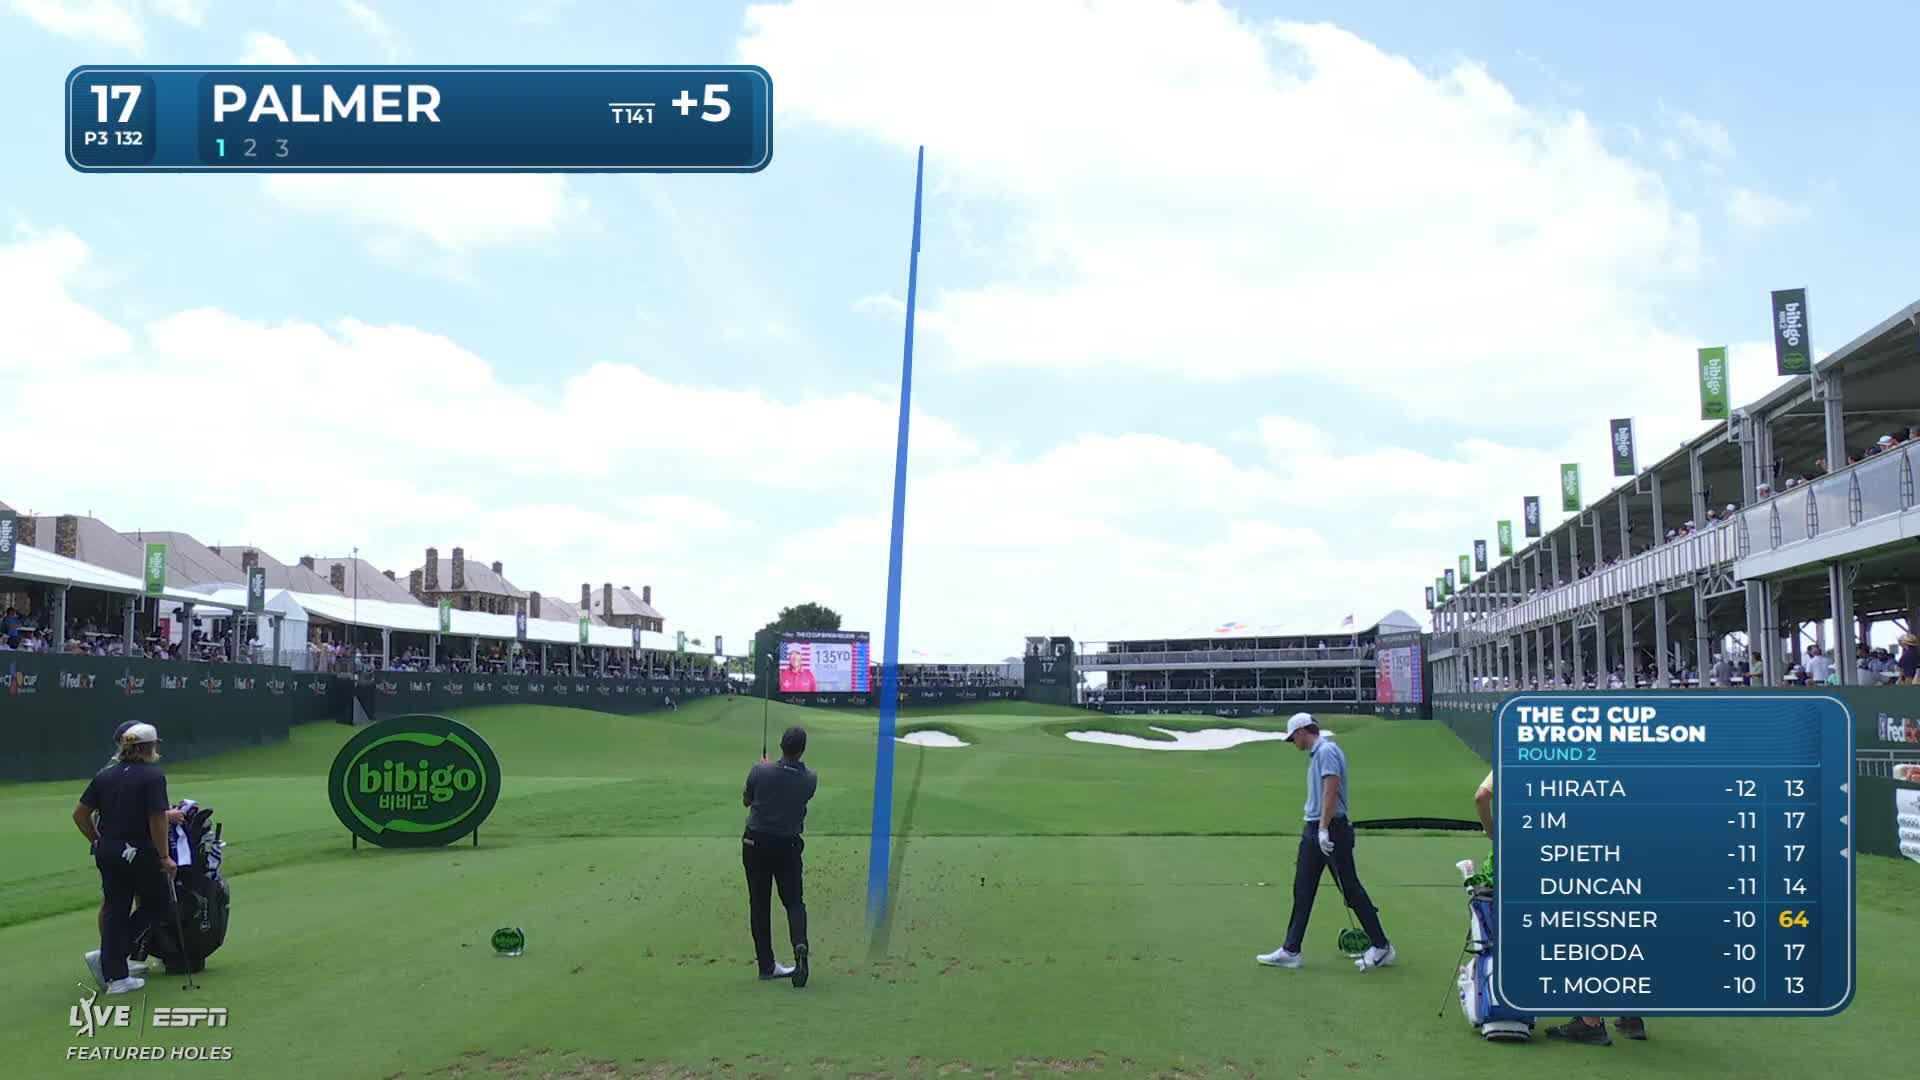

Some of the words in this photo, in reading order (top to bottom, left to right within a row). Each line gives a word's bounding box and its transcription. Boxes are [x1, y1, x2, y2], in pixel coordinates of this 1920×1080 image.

[1783, 302, 1803, 346] bibigo
[1706, 358, 1722, 394] bibigo
[816, 651, 850, 663] 135YD
[1042, 662, 1054, 673] 17
[1887, 717, 1918, 742] FedEx
[359, 760, 476, 802] bibigo
[379, 794, 428, 811] 비비고
